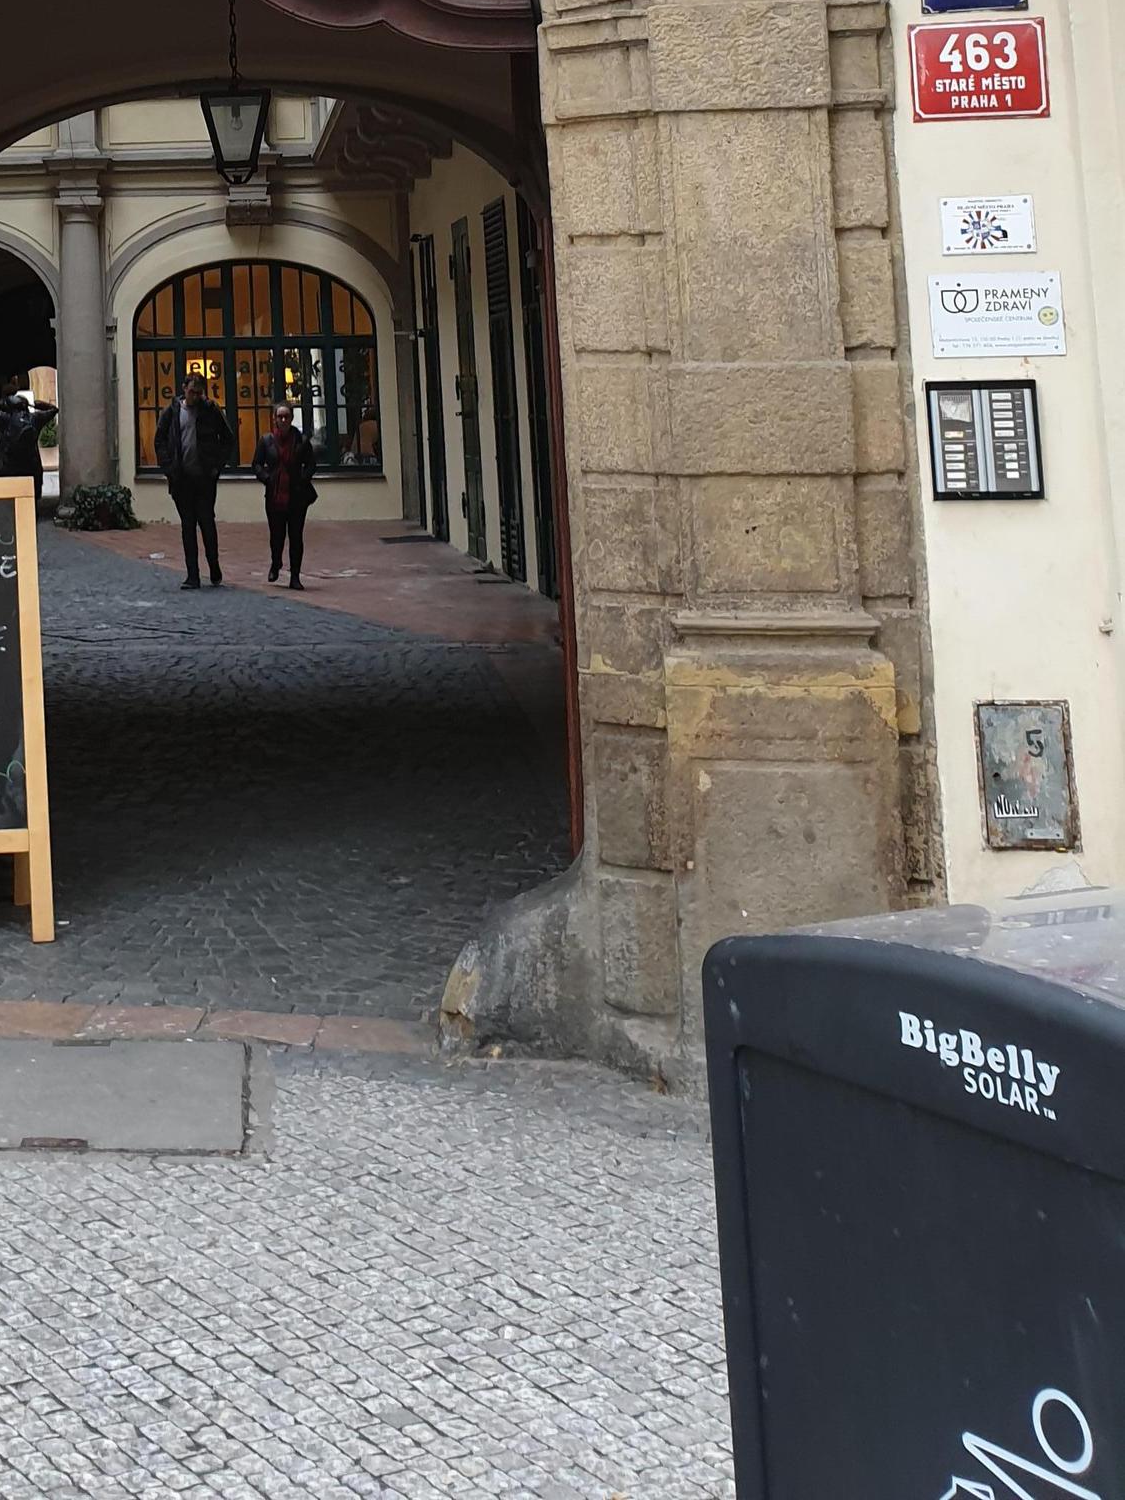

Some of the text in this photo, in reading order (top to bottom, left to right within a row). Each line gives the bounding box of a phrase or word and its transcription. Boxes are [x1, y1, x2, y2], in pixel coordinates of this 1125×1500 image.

[939, 31, 1018, 73] 463
[935, 73, 1026, 93] STARÉ MĚSTO
[951, 93, 1012, 109] PRAHA 1
[984, 287, 1050, 300] PRAMENY
[985, 298, 1032, 312] ZDRAVÍ
[898, 1010, 1061, 1097] BigBelly
[962, 1066, 1041, 1116] SOLAR
